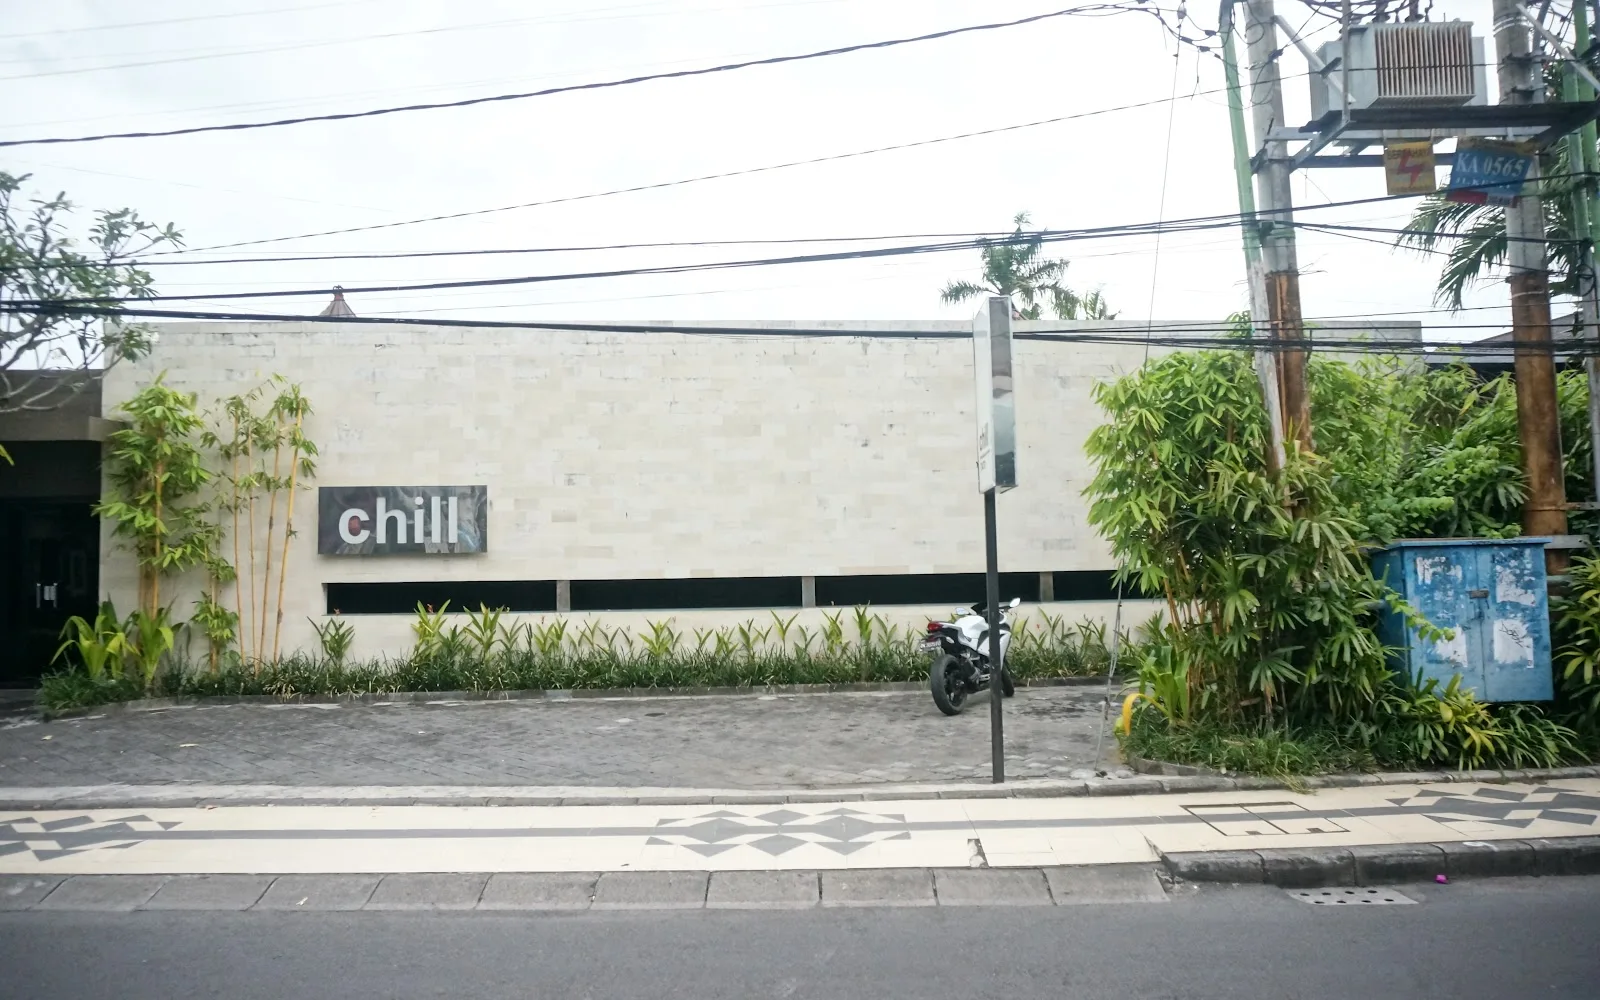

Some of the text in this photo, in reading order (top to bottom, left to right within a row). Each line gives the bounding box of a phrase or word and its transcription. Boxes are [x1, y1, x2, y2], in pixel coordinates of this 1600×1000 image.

[1455, 152, 1525, 177] KA 0565
[338, 496, 458, 545] chill
